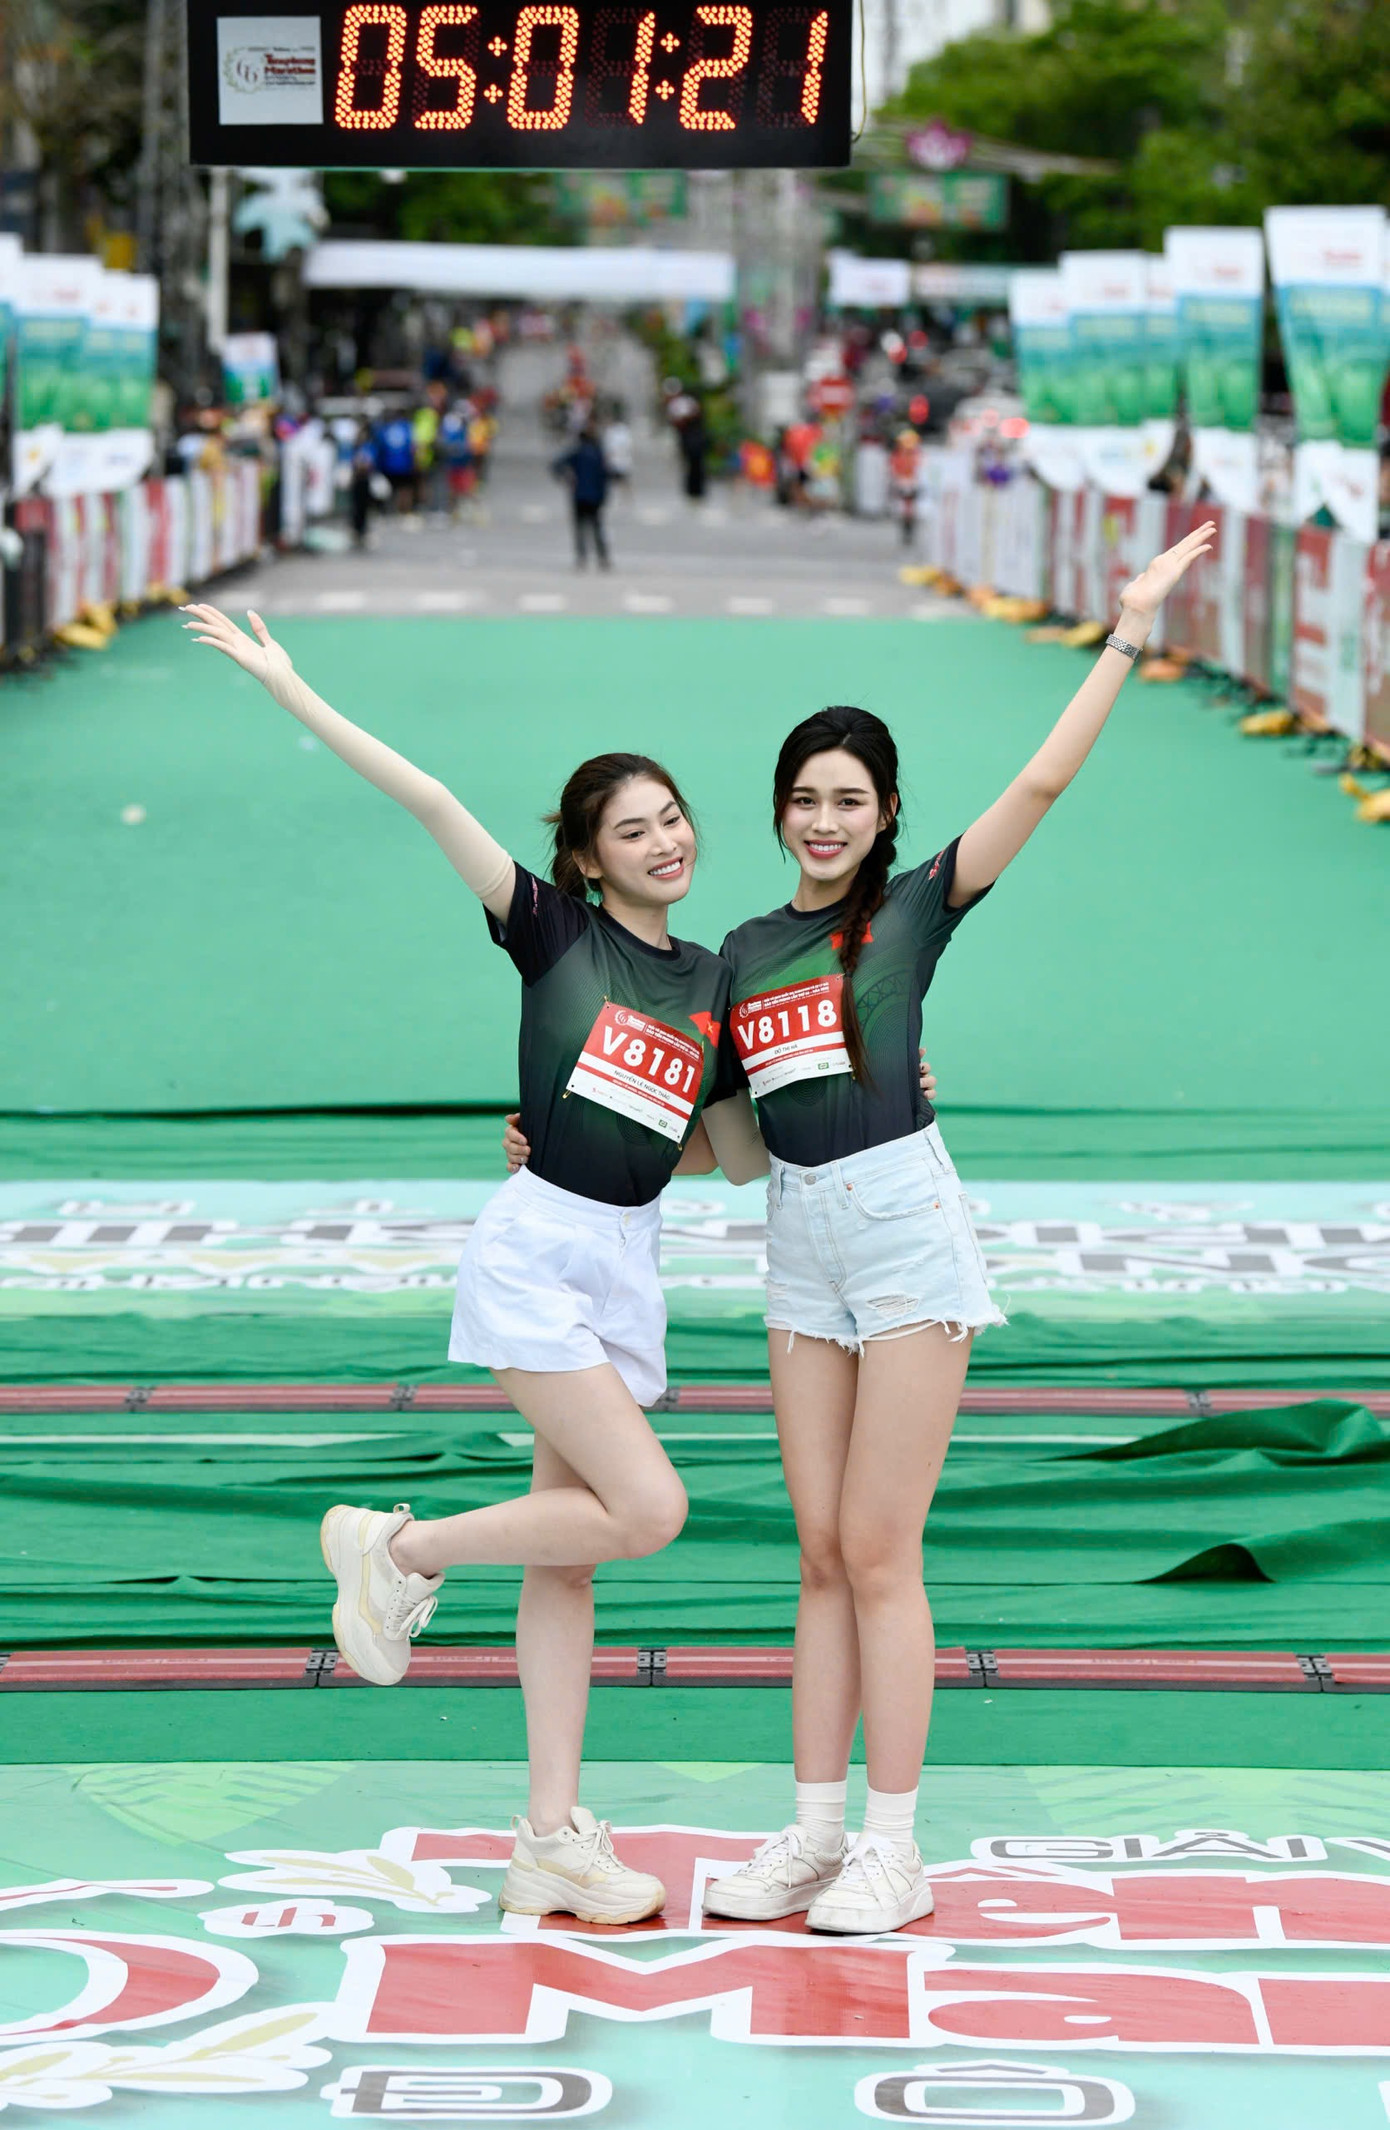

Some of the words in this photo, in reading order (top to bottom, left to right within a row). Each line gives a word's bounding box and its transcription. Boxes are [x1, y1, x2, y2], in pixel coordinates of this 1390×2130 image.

[334, 4, 829, 130] 05:01:21
[737, 999, 838, 1050] V8118
[602, 1025, 696, 1094] V8181
[990, 1831, 1308, 1859] GIẢI
